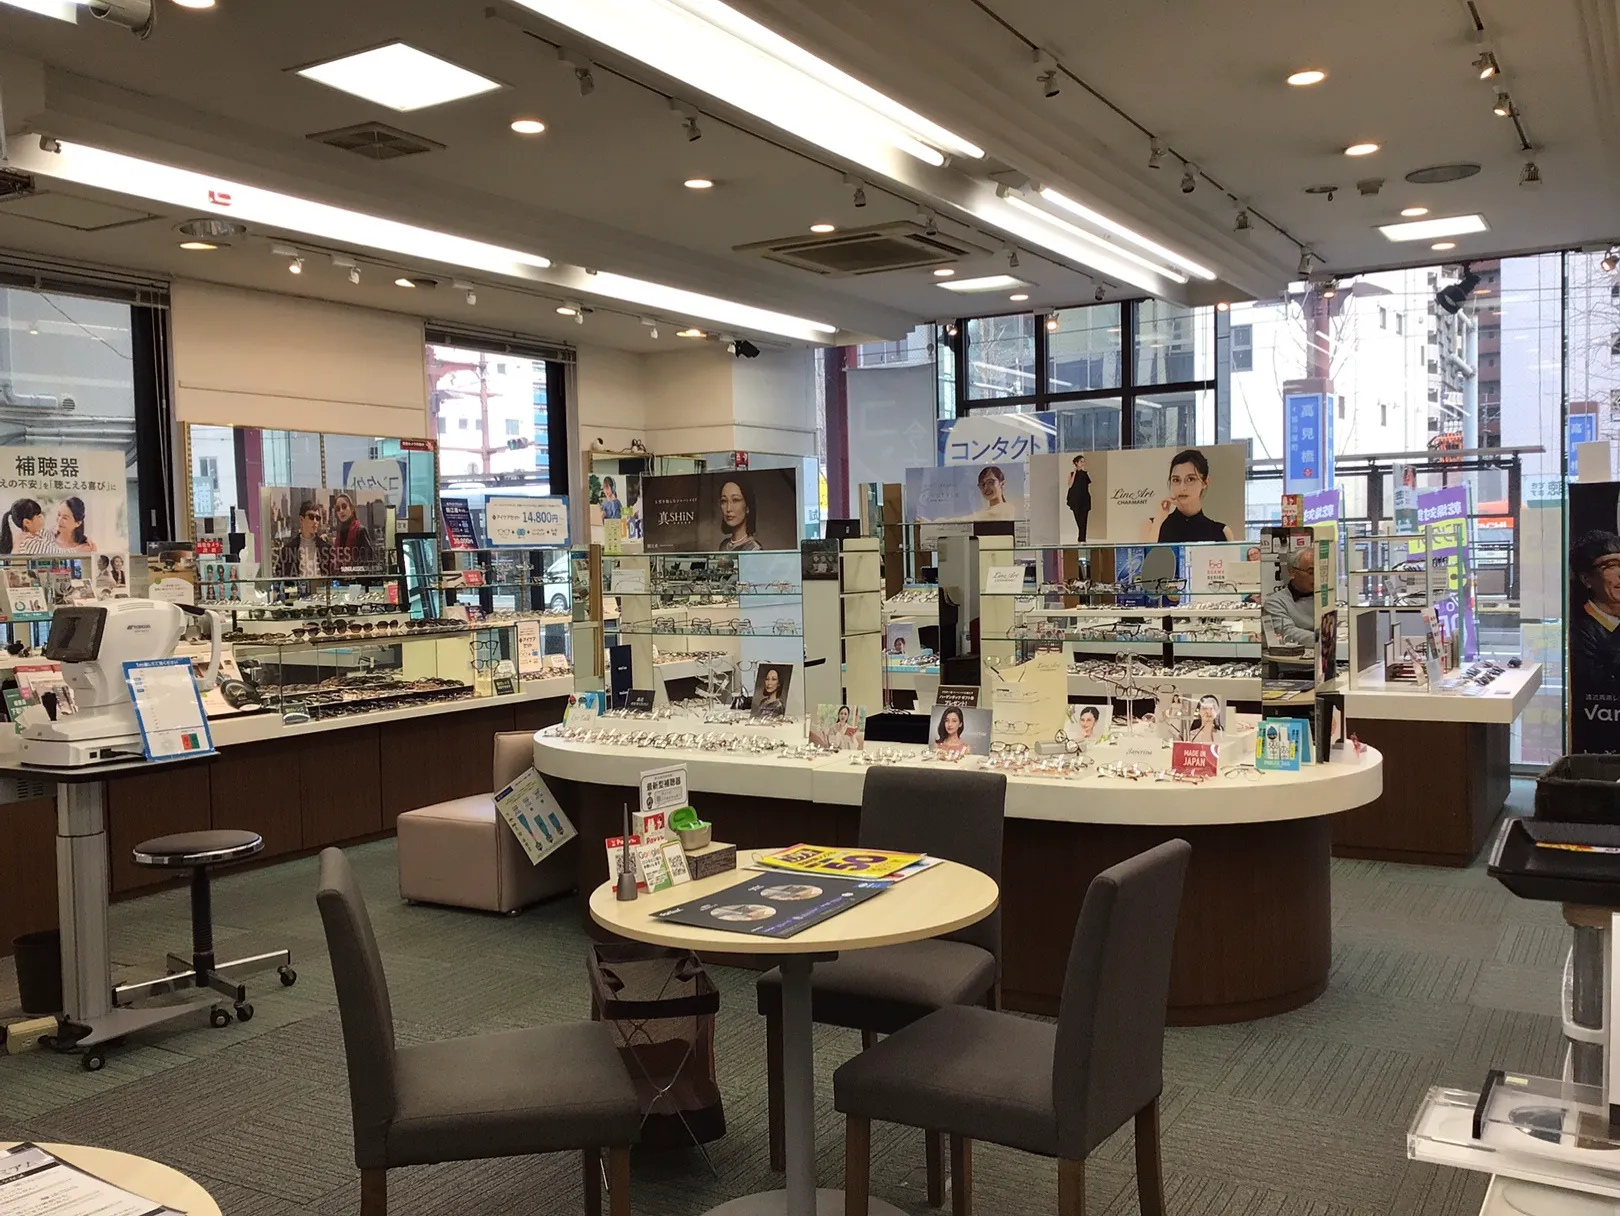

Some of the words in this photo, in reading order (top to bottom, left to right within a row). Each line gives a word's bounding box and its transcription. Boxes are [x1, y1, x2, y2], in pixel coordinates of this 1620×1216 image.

[952, 434, 1041, 461] コンタクト
[15, 456, 79, 477] 補聴器
[1111, 488, 1134, 499] Line
[1133, 488, 1155, 498] Art
[272, 547, 351, 563] SUNGLASSES
[1183, 758, 1205, 766] JAPAN
